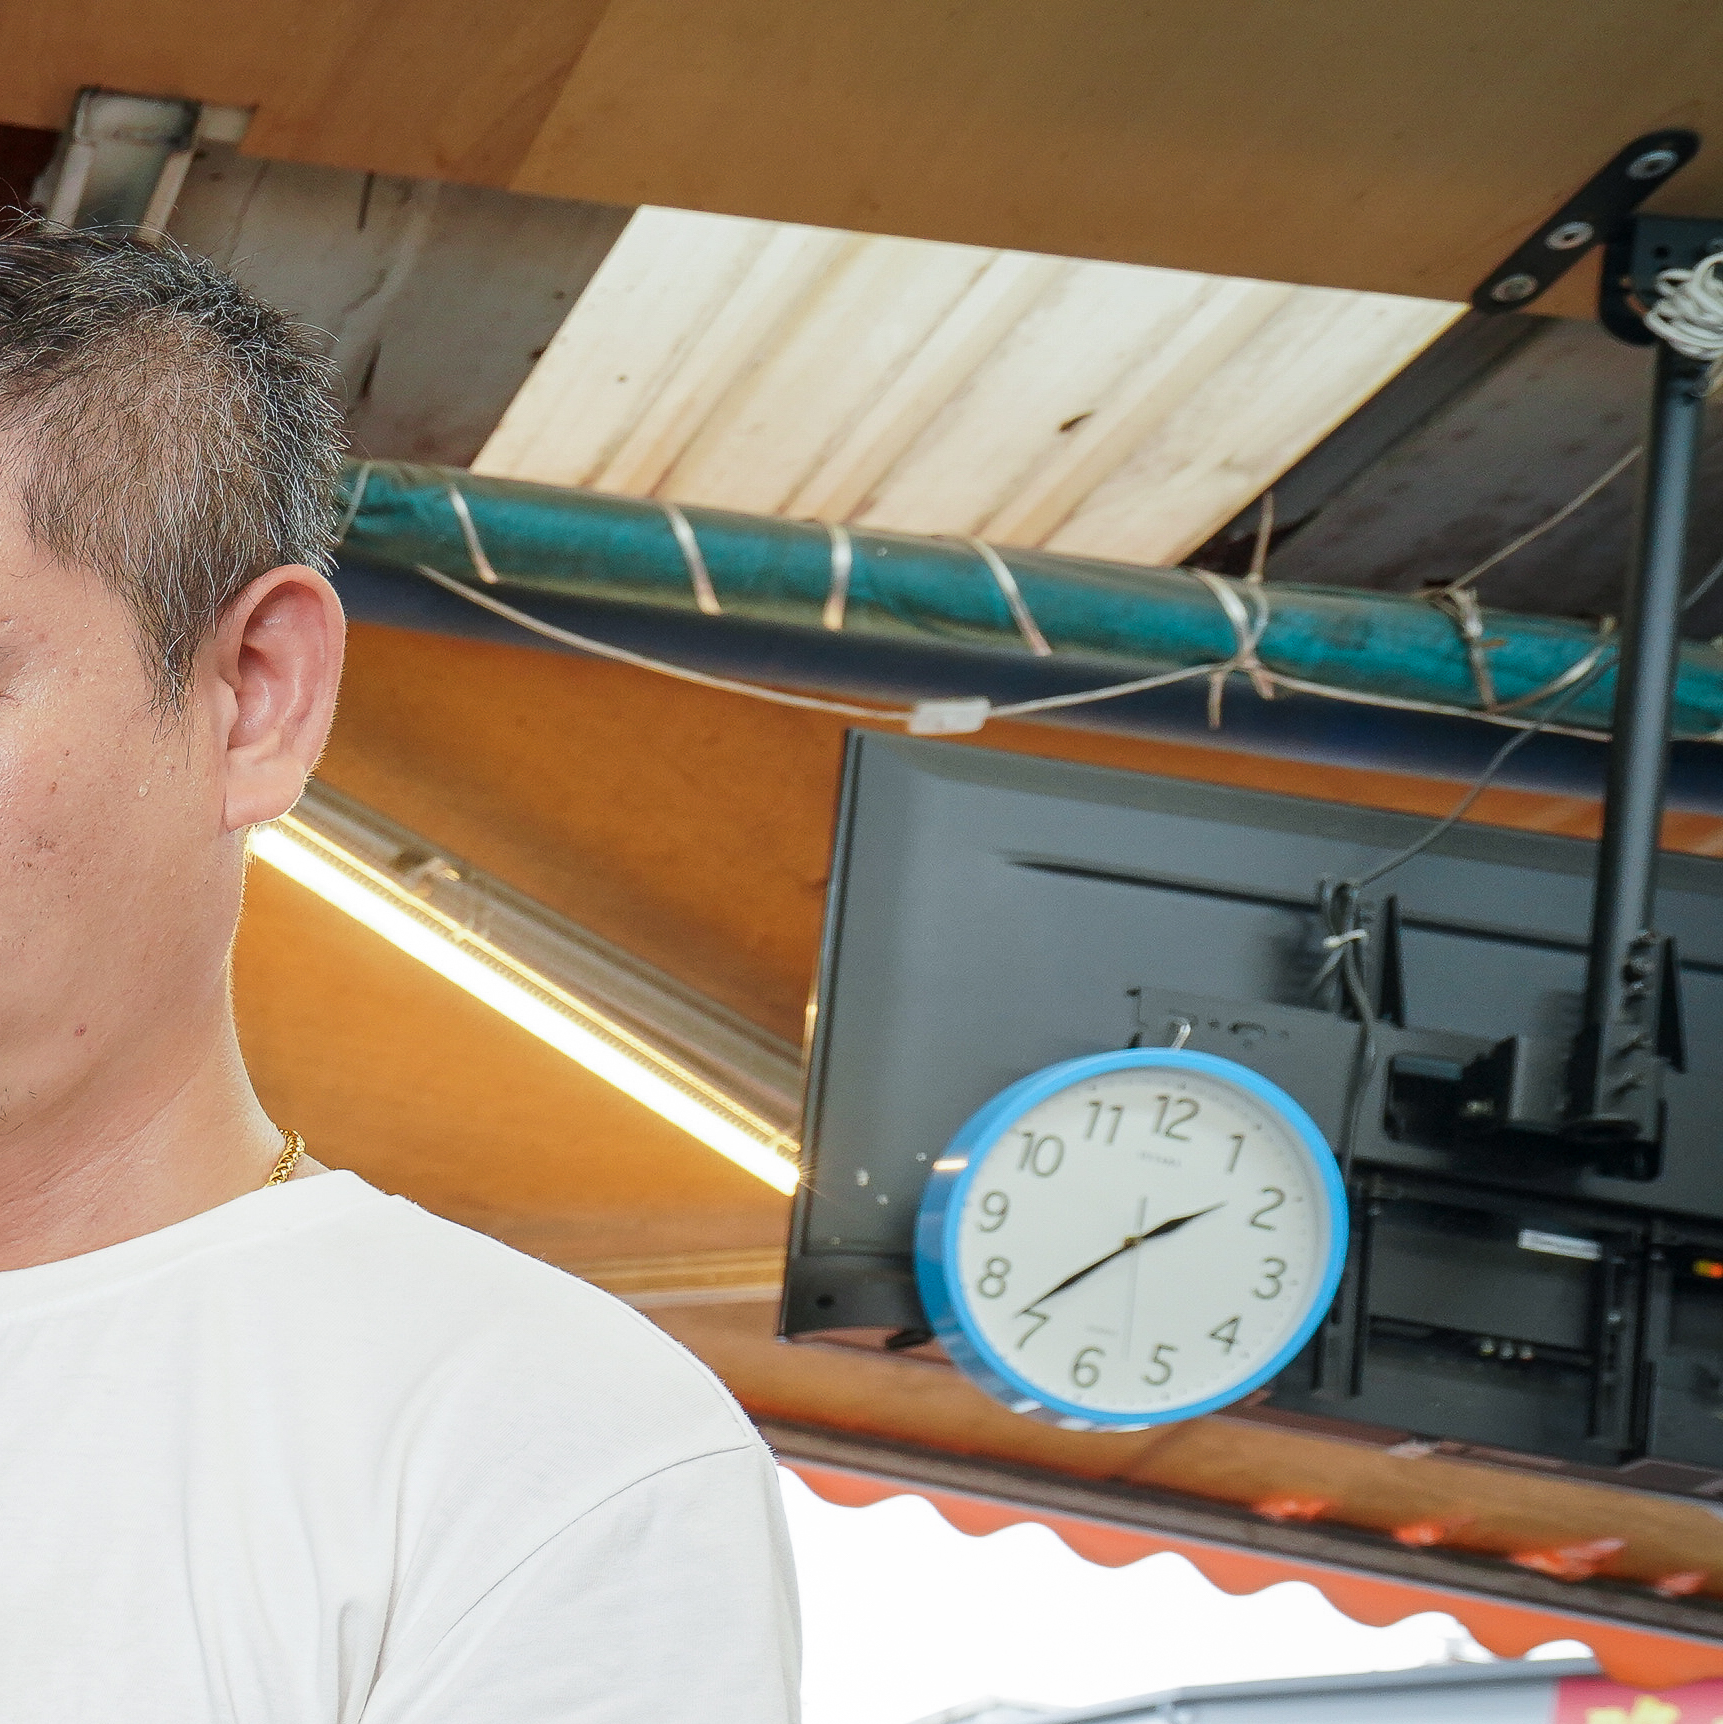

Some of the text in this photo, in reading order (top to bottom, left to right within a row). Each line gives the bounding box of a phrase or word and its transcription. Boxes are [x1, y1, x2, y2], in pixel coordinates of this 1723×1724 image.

[1084, 1101, 1124, 1145] 11
[1155, 1095, 1201, 1142] 12
[1017, 1132, 1065, 1178] 10
[1226, 1133, 1246, 1174] 1
[979, 1190, 1010, 1233] 9
[1249, 1187, 1286, 1231] 2
[977, 1257, 1010, 1299] 8
[1251, 1257, 1287, 1300] 3
[1017, 1308, 1051, 1350] 7
[1208, 1316, 1243, 1355] 4
[1069, 1346, 1106, 1389] 6
[1141, 1344, 1177, 1386] 5
